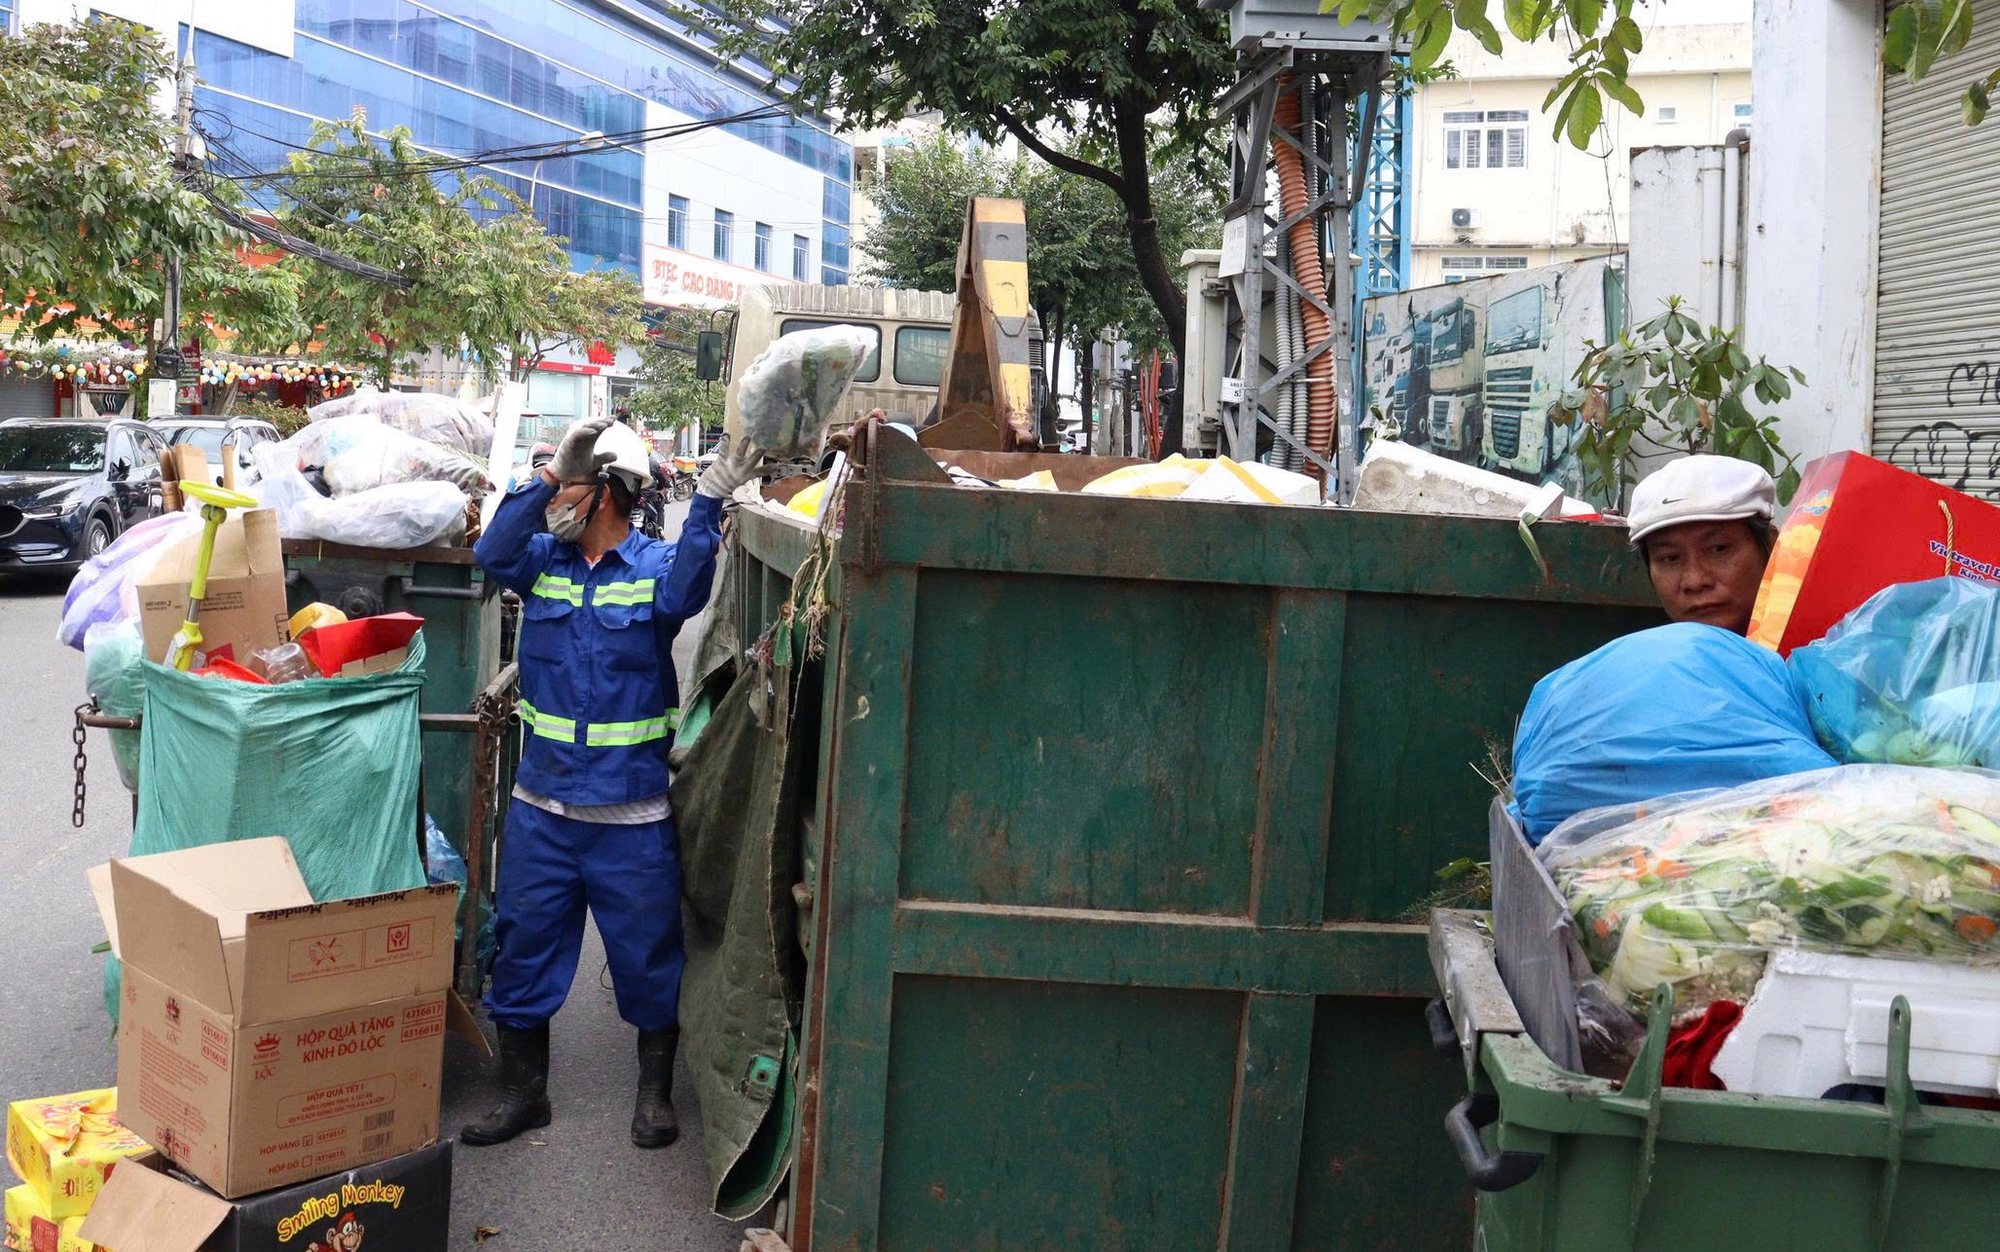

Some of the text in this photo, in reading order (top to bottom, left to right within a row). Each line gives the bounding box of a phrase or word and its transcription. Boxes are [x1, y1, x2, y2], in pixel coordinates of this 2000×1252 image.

[653, 259, 678, 282] BTEC
[682, 271, 704, 294] CAO
[405, 1004, 442, 1019] 4316617
[297, 1015, 395, 1047] HỘP QUÀ TẶNG
[403, 1023, 440, 1039] 4316618
[302, 1046, 335, 1063] KINH
[360, 1035, 386, 1054] LỘC
[277, 1179, 404, 1242] Smiling Monkey
